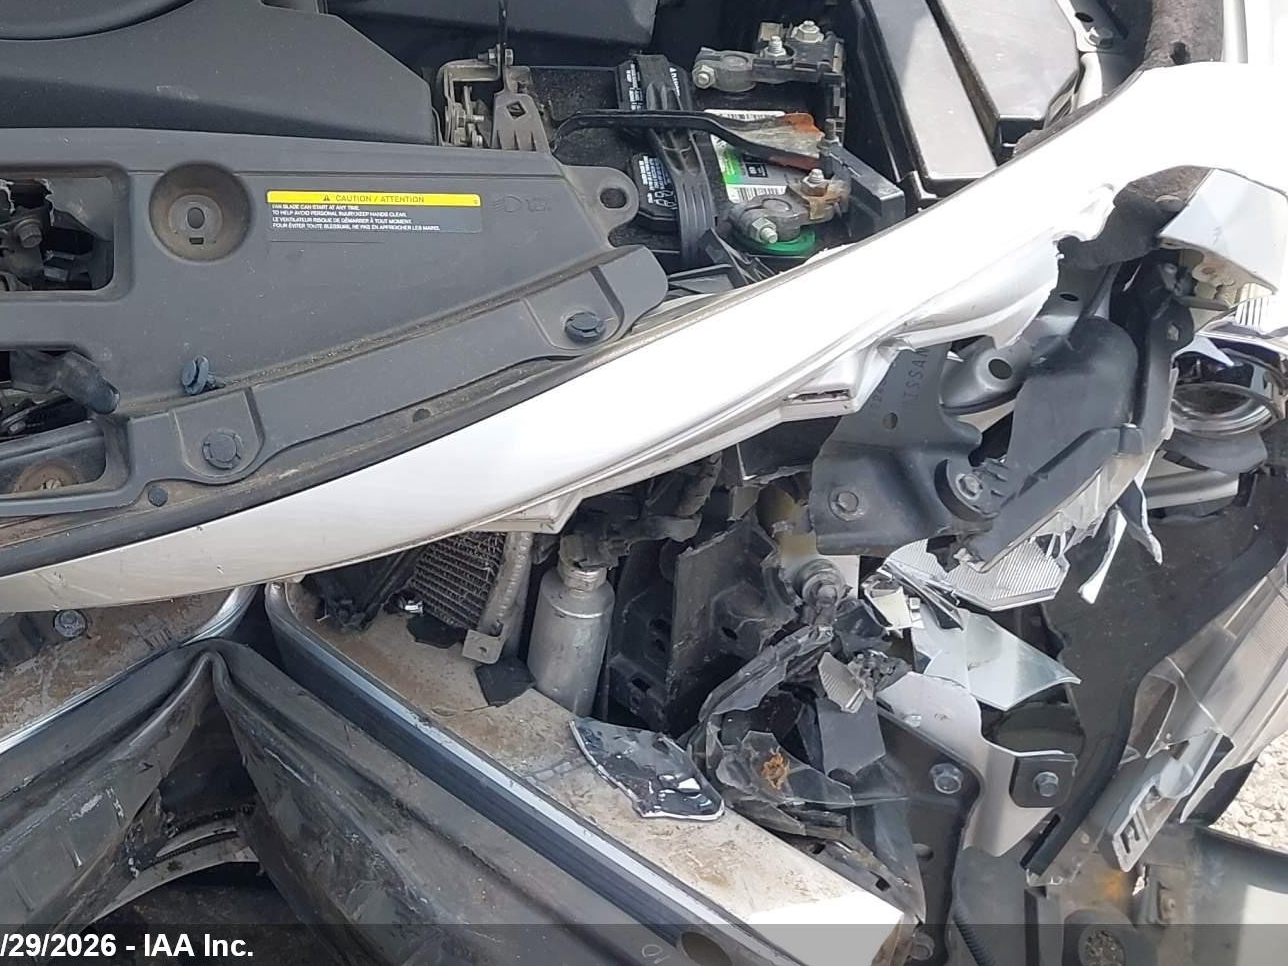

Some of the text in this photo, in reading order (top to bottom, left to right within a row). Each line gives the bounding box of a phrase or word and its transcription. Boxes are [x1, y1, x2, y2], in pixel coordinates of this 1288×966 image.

[335, 194, 372, 202] CAUTION
[380, 195, 424, 203] ATTENTION
[902, 346, 929, 410] ISSAN
